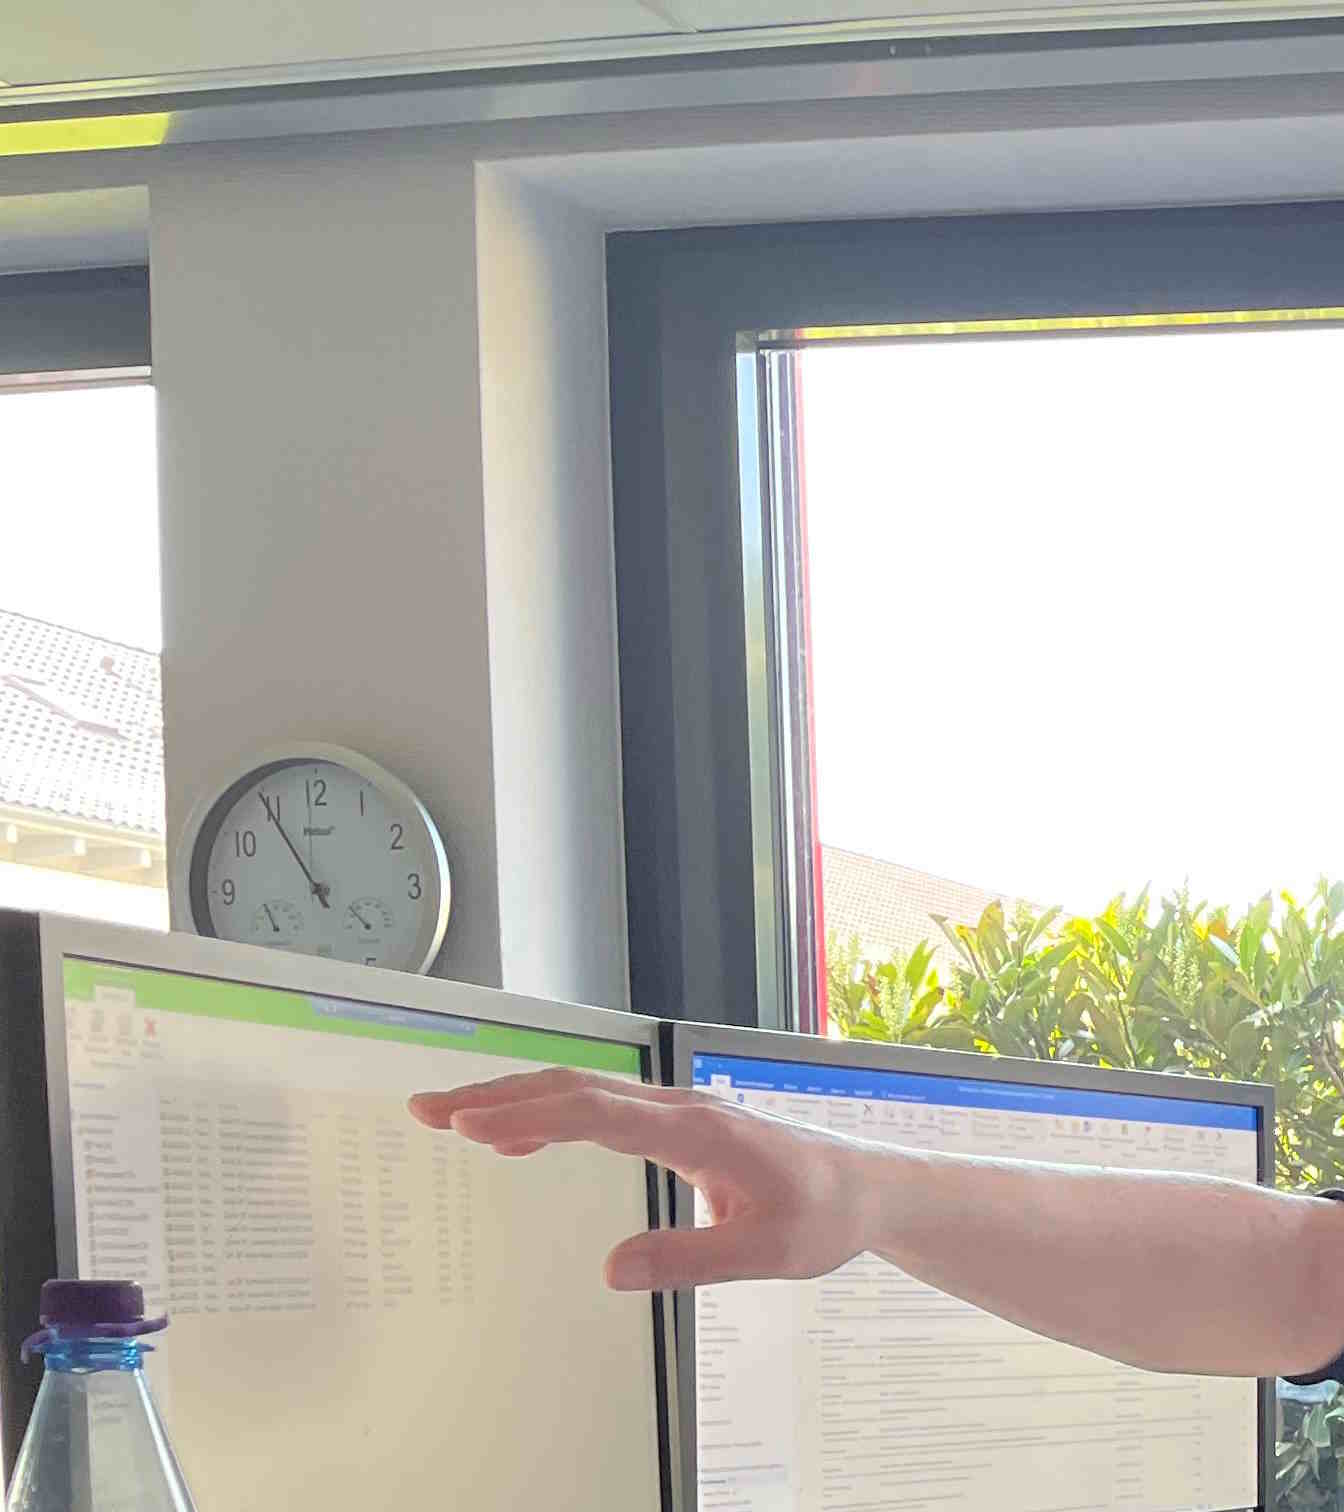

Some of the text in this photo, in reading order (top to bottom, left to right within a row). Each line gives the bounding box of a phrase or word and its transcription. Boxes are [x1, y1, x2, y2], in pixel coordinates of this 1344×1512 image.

[305, 779, 328, 806] 12
[359, 789, 365, 817] 1
[235, 830, 257, 857] 10
[389, 823, 405, 850] 2
[221, 879, 236, 905] 9
[407, 873, 422, 900] 3
